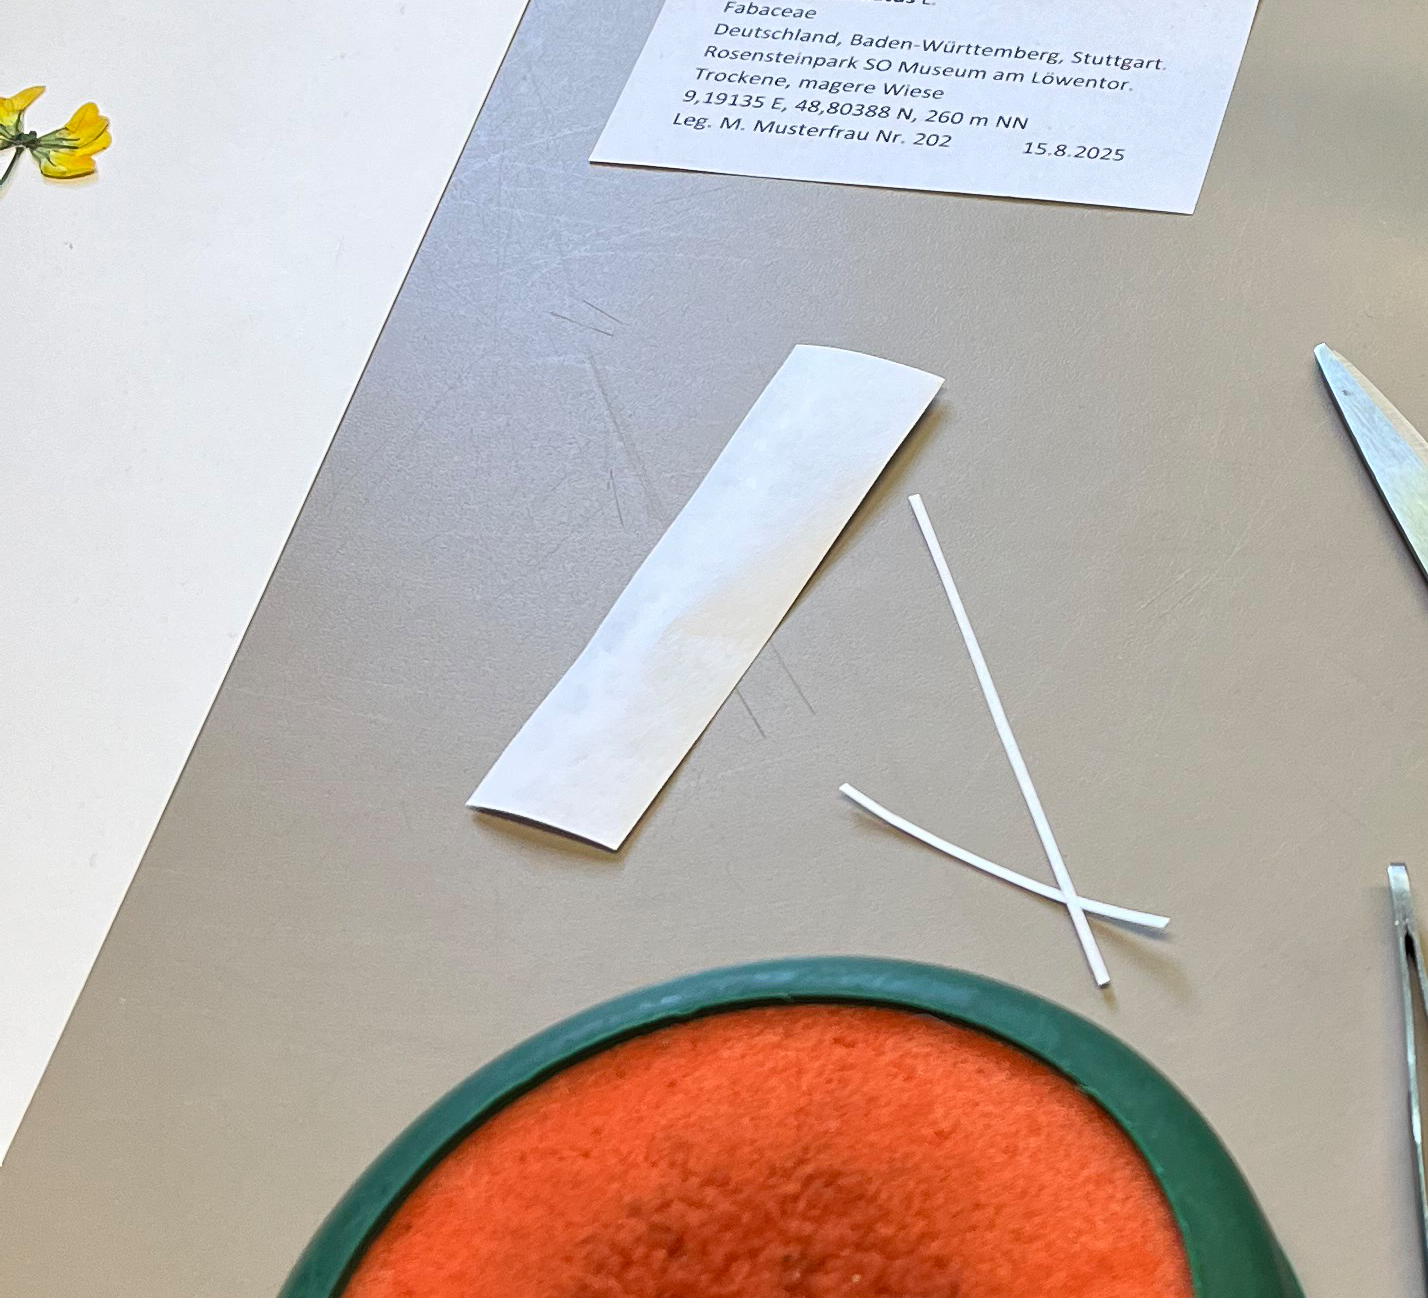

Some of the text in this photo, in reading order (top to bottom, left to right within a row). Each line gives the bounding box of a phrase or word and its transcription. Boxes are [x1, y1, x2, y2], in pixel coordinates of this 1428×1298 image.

[723, 1, 817, 20] Fabaceae
[713, 23, 1168, 71] Deutschland, Baden-Württemberg, Stuttgart.
[695, 67, 945, 100] Trockene, magere Wiese
[703, 45, 1134, 92] Rosensteinpark SO Museum am Löwentor.
[682, 89, 1029, 130] 9,19135 E, 48,80388 N, 260 m NN
[672, 112, 952, 148] Leg. M. Musterfrau Nr. 202
[1022, 142, 1126, 162] 15.8.2025
